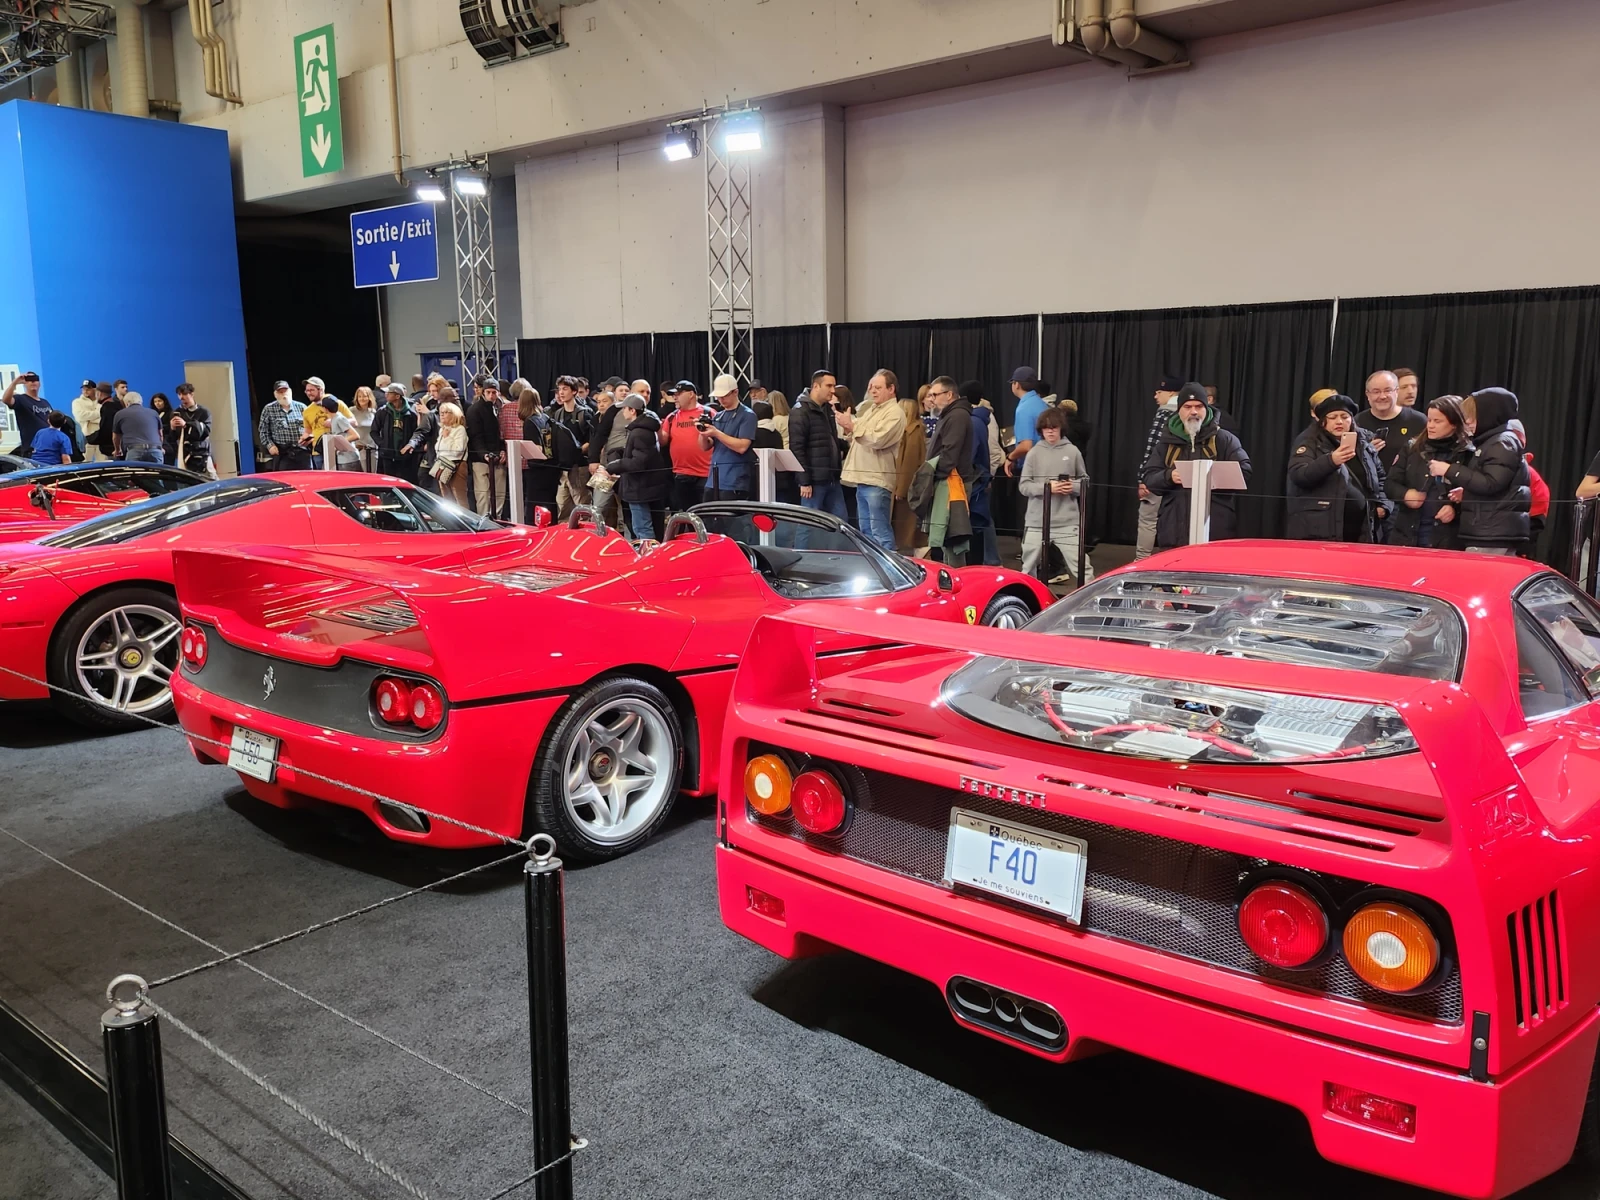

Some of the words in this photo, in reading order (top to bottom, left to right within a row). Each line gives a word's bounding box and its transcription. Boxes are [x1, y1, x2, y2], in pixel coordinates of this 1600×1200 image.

[356, 218, 432, 246] Sortie/Exit
[242, 740, 260, 765] F50
[1000, 830, 1043, 851] Québec
[989, 840, 1038, 885] F40
[978, 876, 989, 886] Je
[990, 881, 1003, 891] me
[1005, 886, 1044, 904] souviens
